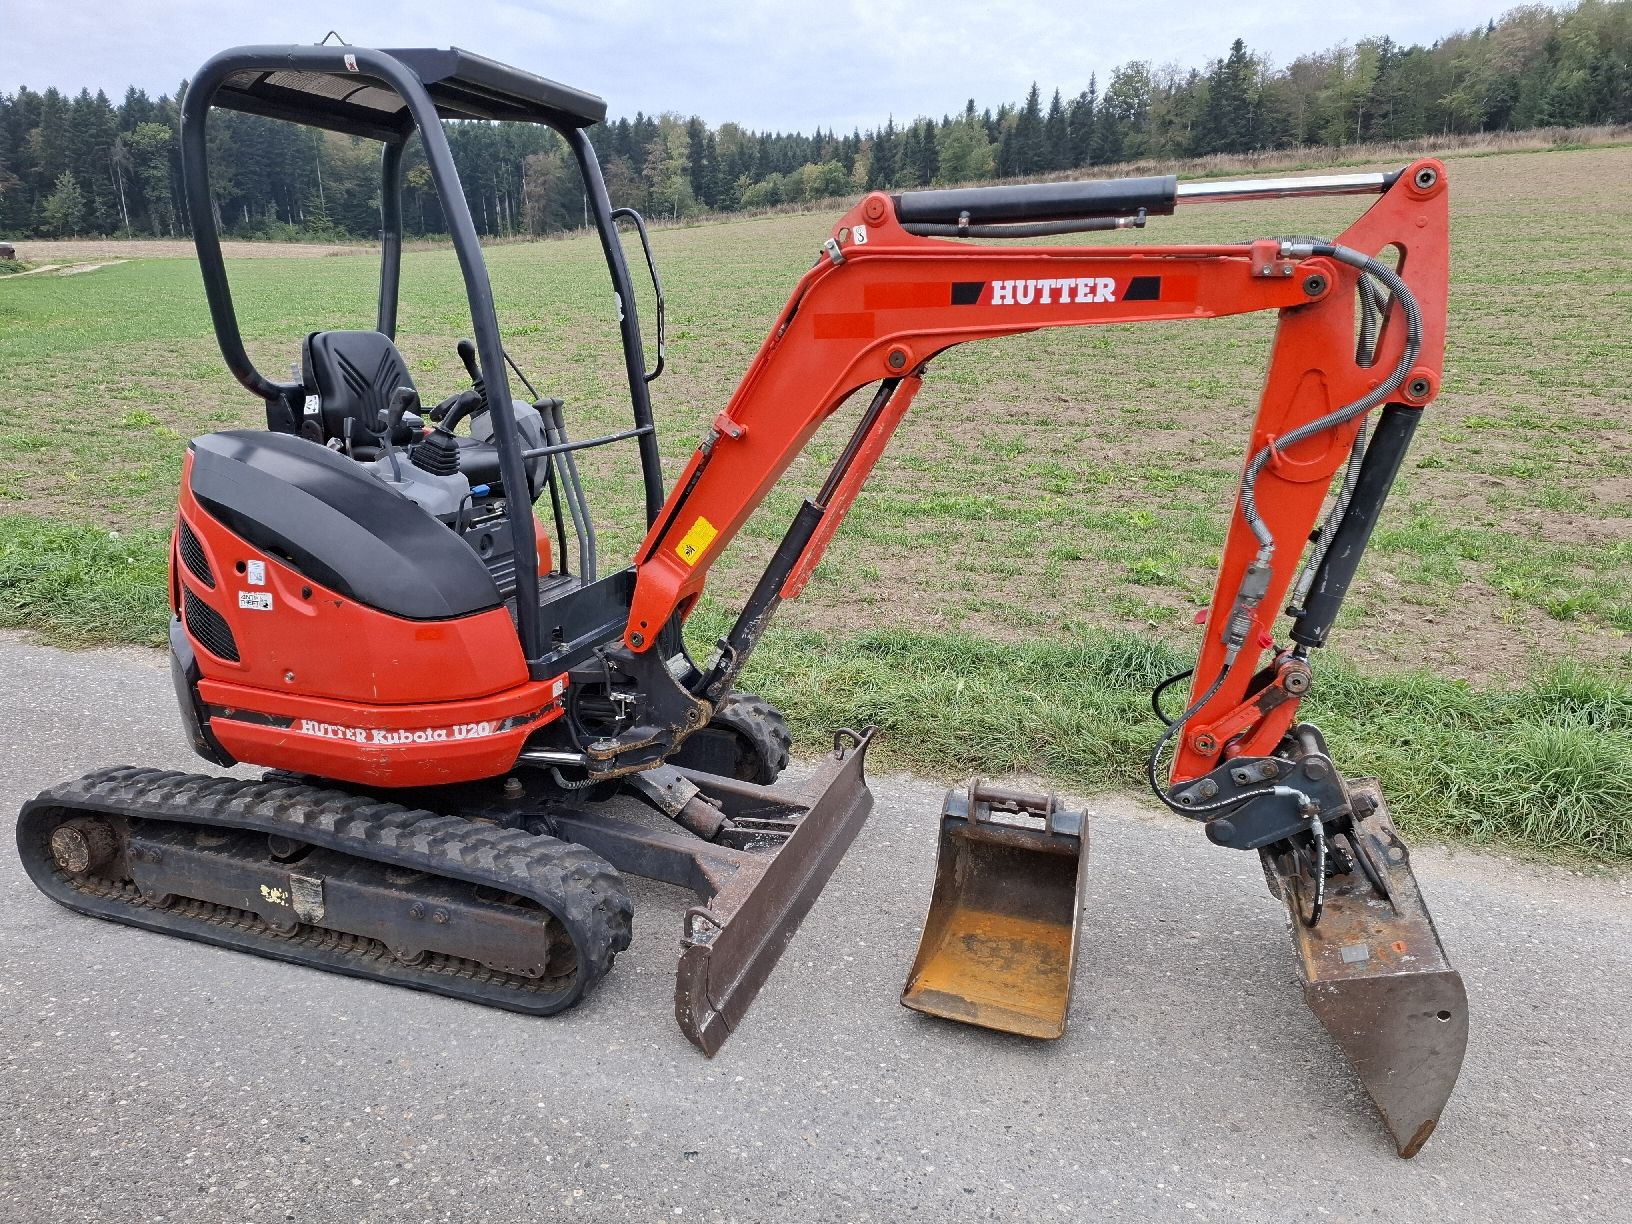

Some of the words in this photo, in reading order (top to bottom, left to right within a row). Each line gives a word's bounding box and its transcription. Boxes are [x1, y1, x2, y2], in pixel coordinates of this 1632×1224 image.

[992, 277, 1116, 305] HUTTER
[301, 719, 367, 743] HUTTER
[371, 728, 447, 744] Kubota
[452, 722, 490, 740] U20
